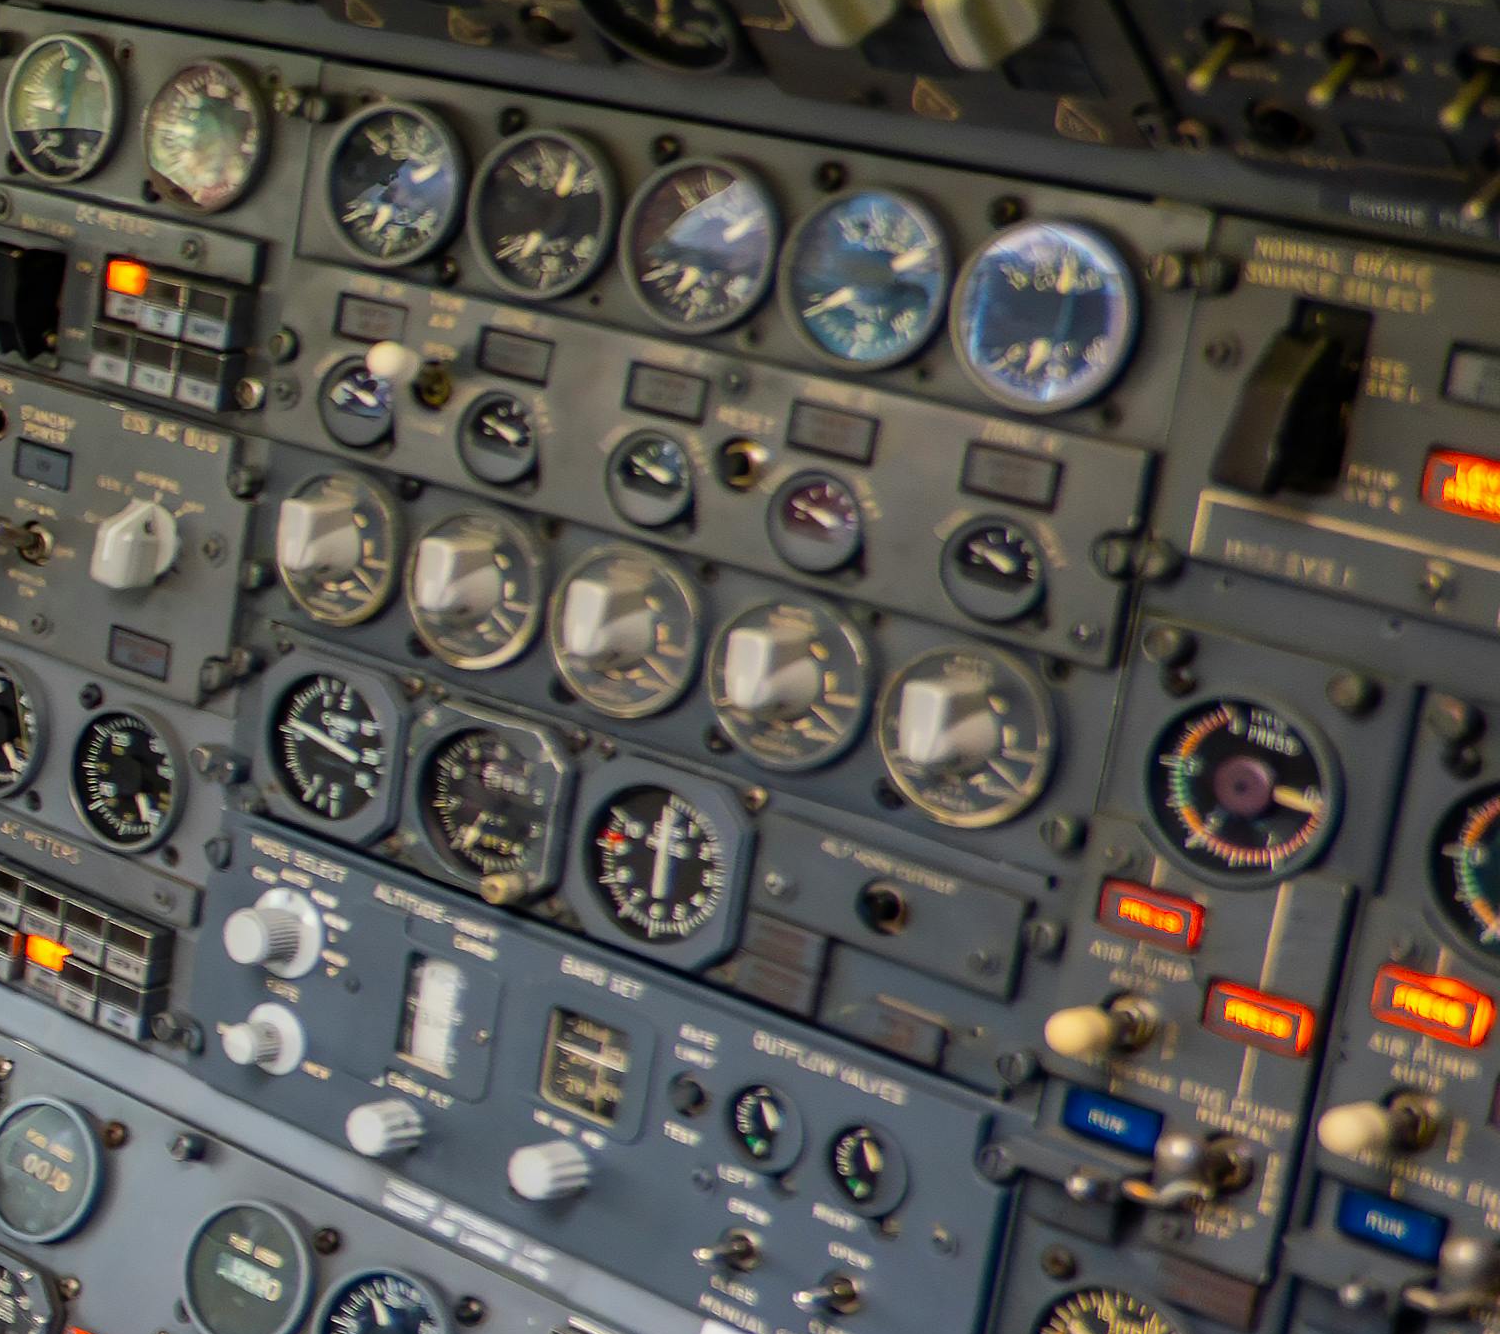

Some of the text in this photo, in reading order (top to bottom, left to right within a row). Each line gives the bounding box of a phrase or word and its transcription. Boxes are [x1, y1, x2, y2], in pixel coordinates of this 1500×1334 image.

[20, 405, 75, 429] STANDBY
[24, 423, 66, 443] POWER
[1248, 725, 1301, 756] PRESS
[251, 835, 348, 882] MODE SELECT
[1119, 897, 1183, 933] PRESS
[1090, 940, 1191, 981] AIR PUMP
[1225, 999, 1293, 1039] PRESS
[1390, 984, 1469, 1031] PRESS
[753, 1030, 909, 1105] OUTFLOW VALVES
[664, 1121, 699, 1146] TEST
[1088, 1107, 1128, 1133] RUN
[1196, 1107, 1271, 1143] NORMAL
[710, 1275, 759, 1305] CLOSE
